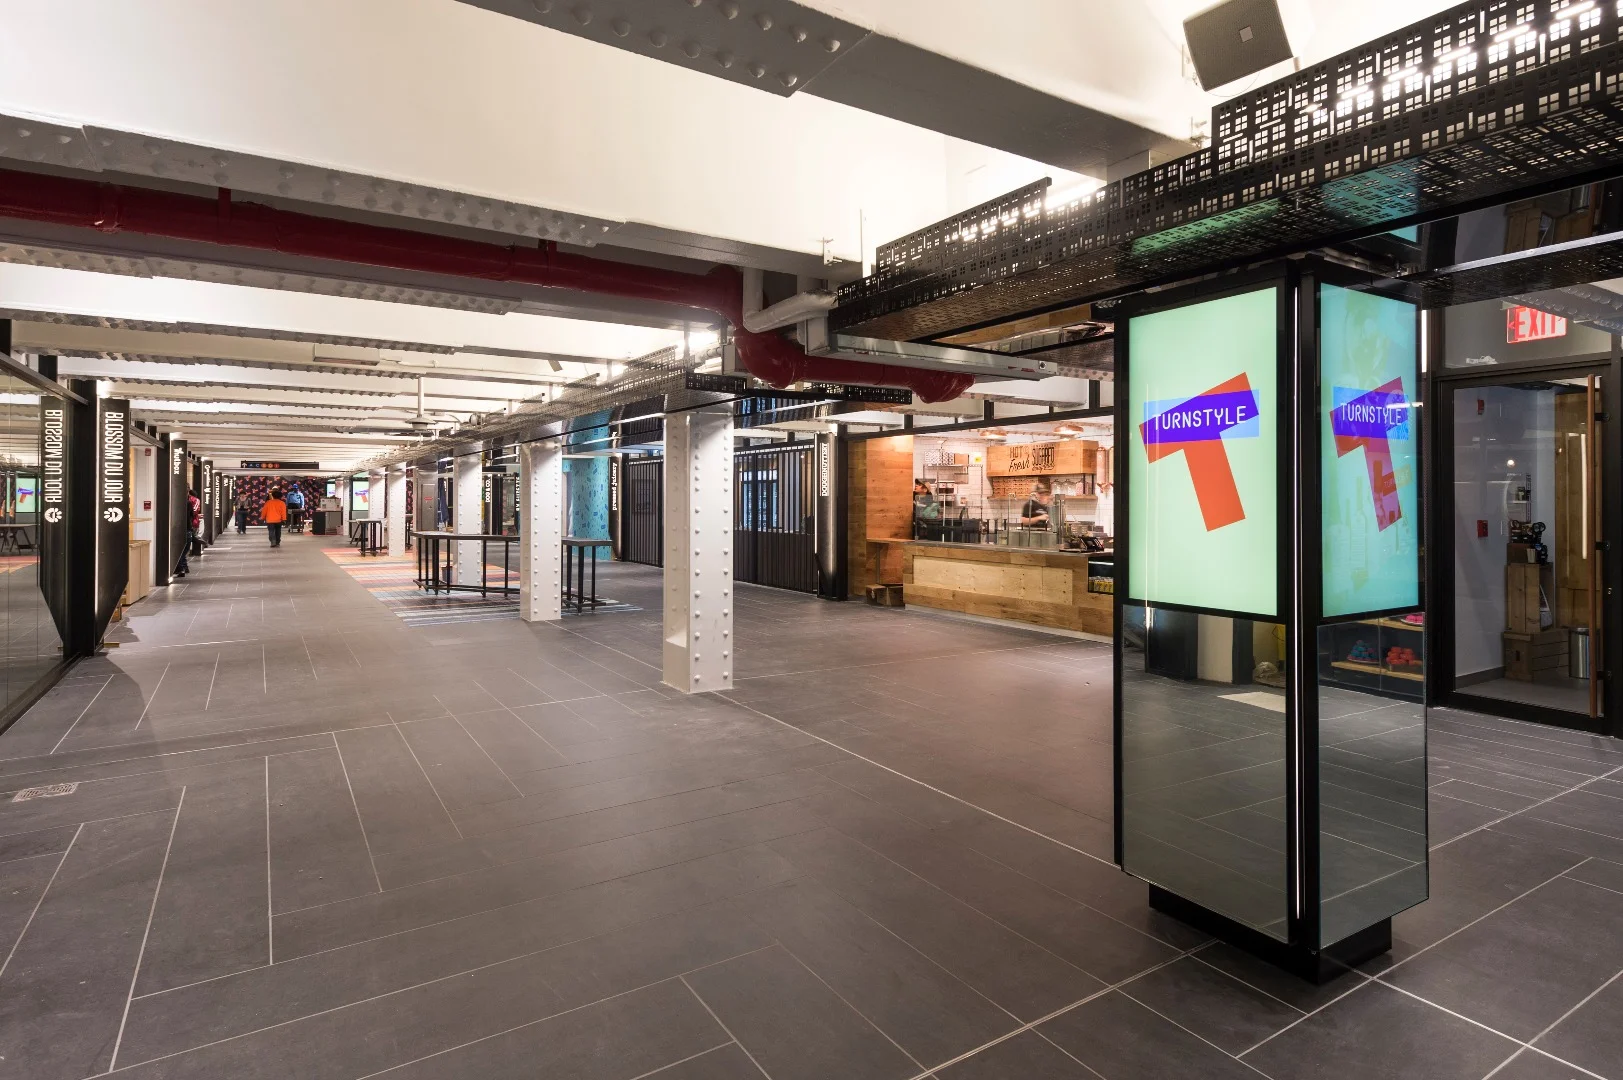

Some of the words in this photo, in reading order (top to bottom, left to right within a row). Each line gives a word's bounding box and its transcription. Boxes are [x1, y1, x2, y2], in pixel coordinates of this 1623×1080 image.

[1515, 307, 1556, 339] EXIT
[1152, 404, 1248, 431] TURNSTYLE
[1340, 402, 1404, 427] TURNSTYLE
[104, 411, 124, 460] BLOSSOM
[104, 462, 124, 476] DU
[821, 442, 829, 497] DOUGHNUTTERY
[104, 477, 124, 503] JOUR
